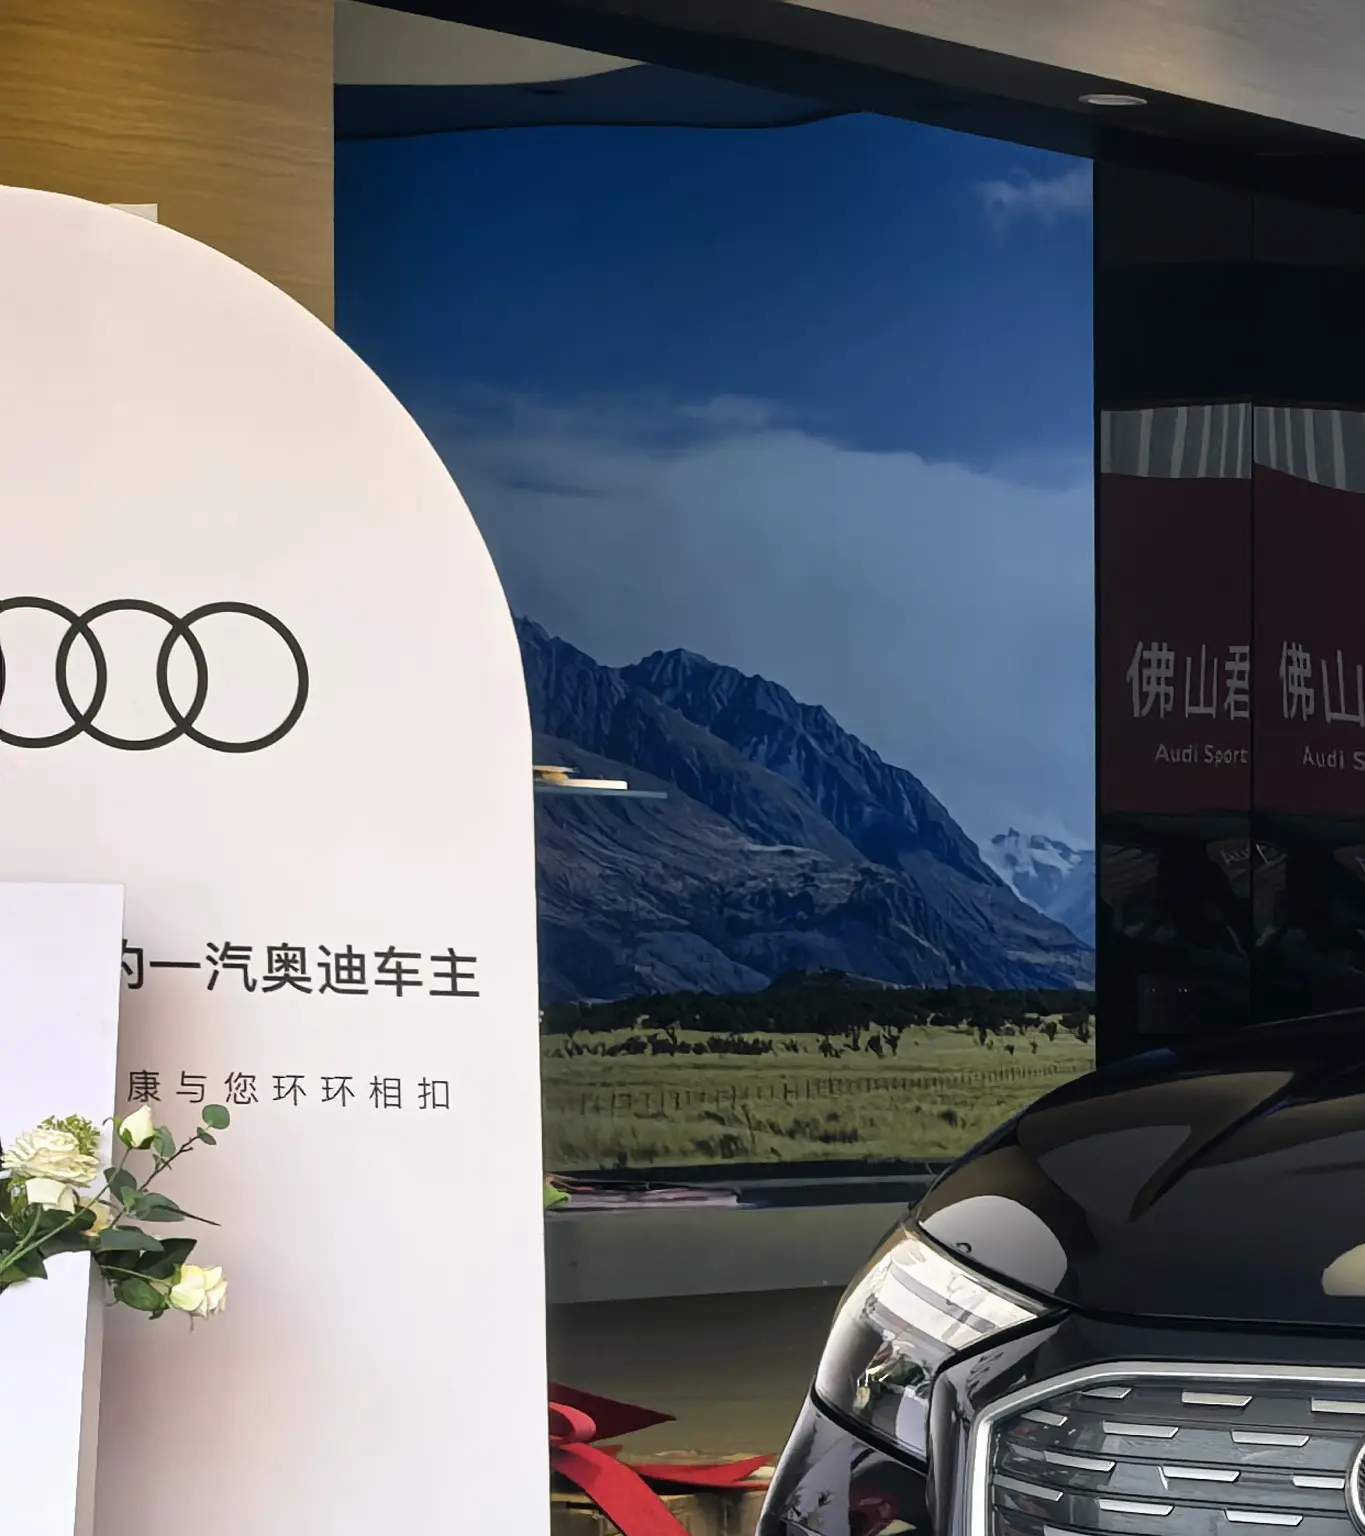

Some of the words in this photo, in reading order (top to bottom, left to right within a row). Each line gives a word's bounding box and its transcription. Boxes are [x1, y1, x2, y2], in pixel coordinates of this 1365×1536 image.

[1154, 744, 1198, 764] Audi
[1203, 744, 1249, 768] Sport
[1302, 746, 1345, 769] Audi
[127, 1069, 450, 1110] 康与您环环相扣
